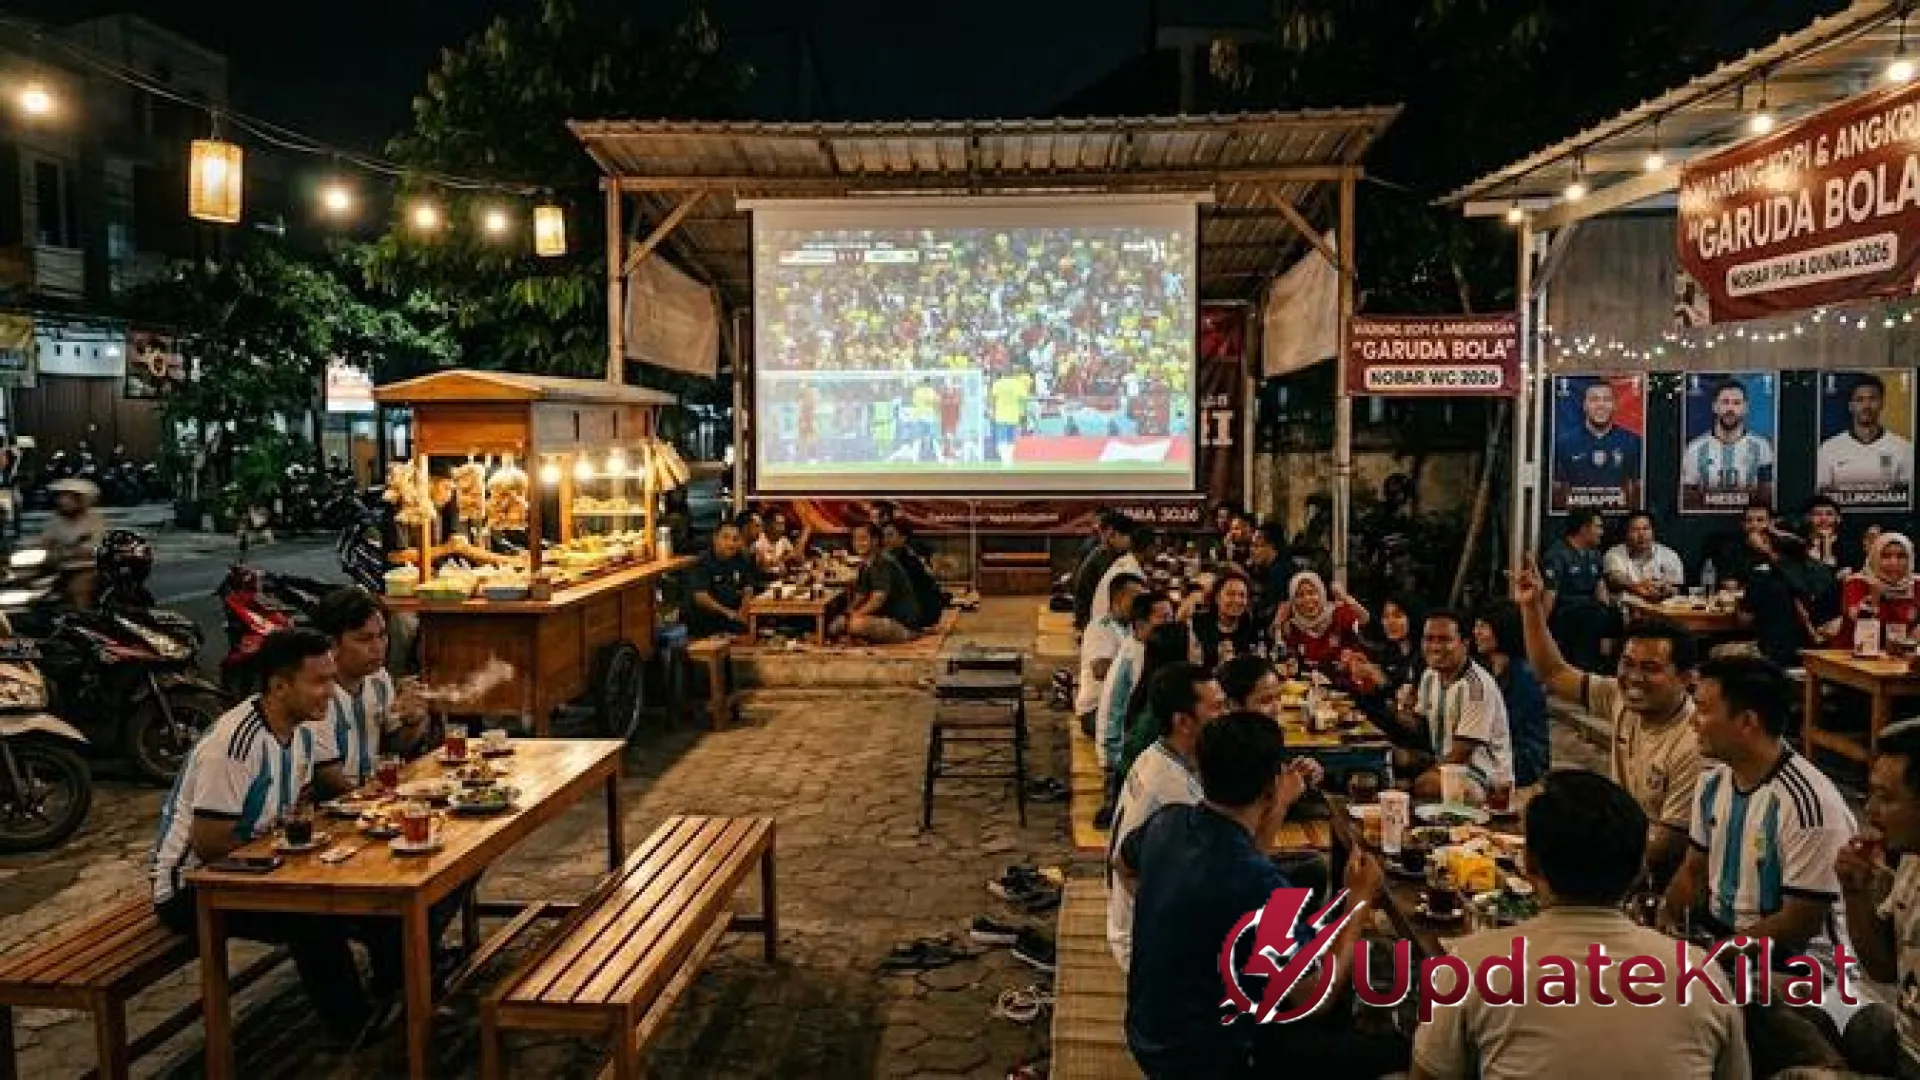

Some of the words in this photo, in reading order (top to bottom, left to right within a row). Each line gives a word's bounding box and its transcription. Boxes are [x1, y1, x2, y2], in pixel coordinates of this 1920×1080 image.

[1767, 140, 1812, 184] KOPI
[1816, 134, 1829, 166] &
[1688, 188, 1815, 259] "GARUDA
[1731, 264, 1770, 290] NOBAR
[1773, 257, 1807, 283] PIALA
[1808, 248, 1852, 275] DUNIA
[1852, 240, 1890, 267] 2026
[1352, 339, 1448, 359] "GARUDA
[1452, 338, 1516, 359] BOLA"
[1371, 370, 1426, 385] NOBAR
[1429, 370, 1457, 385] WC
[1460, 370, 1499, 385] 2026
